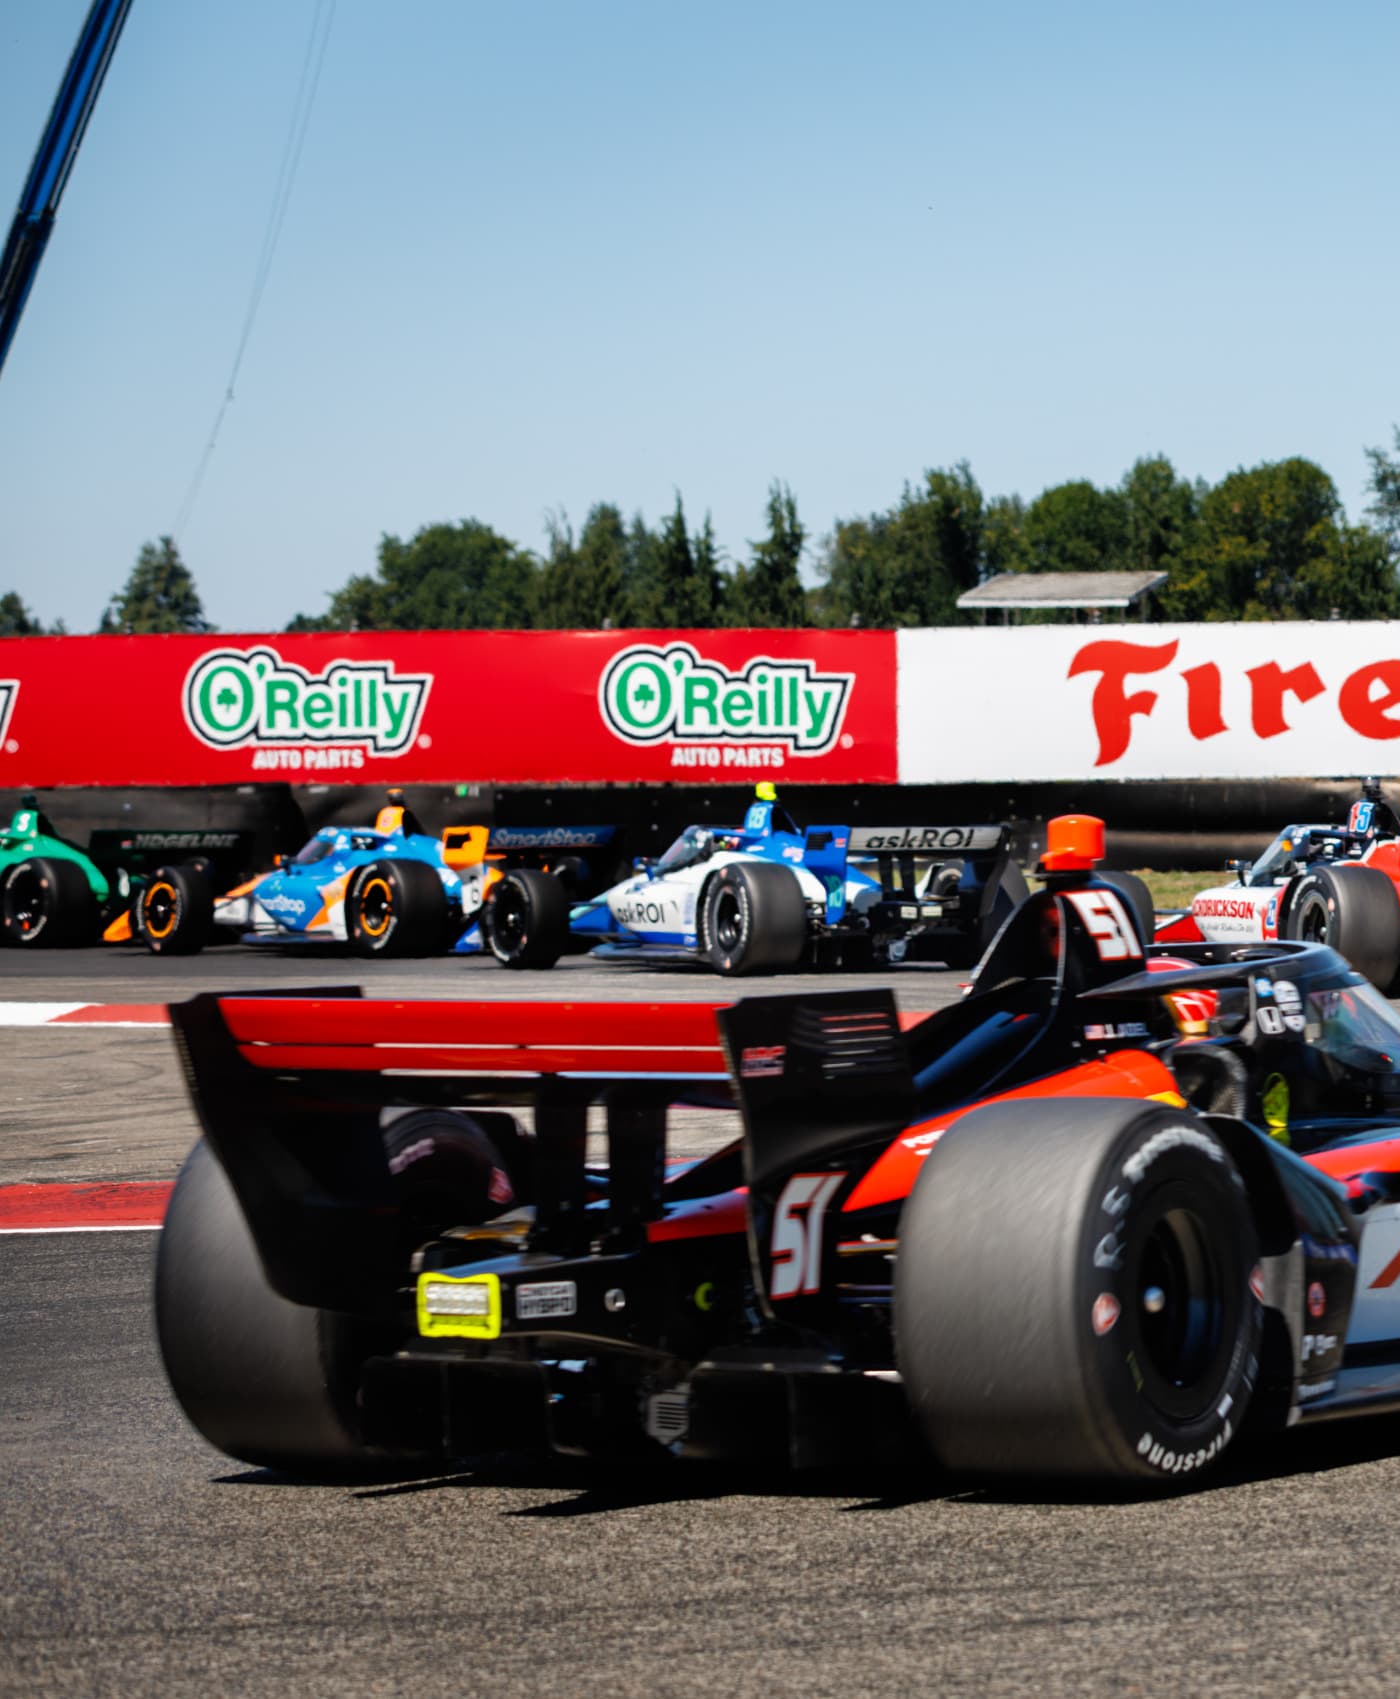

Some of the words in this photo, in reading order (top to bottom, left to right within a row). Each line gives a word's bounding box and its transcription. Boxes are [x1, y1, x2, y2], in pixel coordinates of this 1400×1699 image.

[199, 662, 411, 739] O'Reilly
[615, 658, 832, 739] O'Reilly
[252, 749, 302, 770] AUTO
[303, 748, 365, 770] PARTS
[671, 747, 721, 767] AUTO
[723, 747, 785, 768] PARTS
[865, 828, 975, 849] askROI
[1348, 801, 1376, 834] 15
[1062, 888, 1143, 960] 51
[769, 1171, 848, 1300] 51
